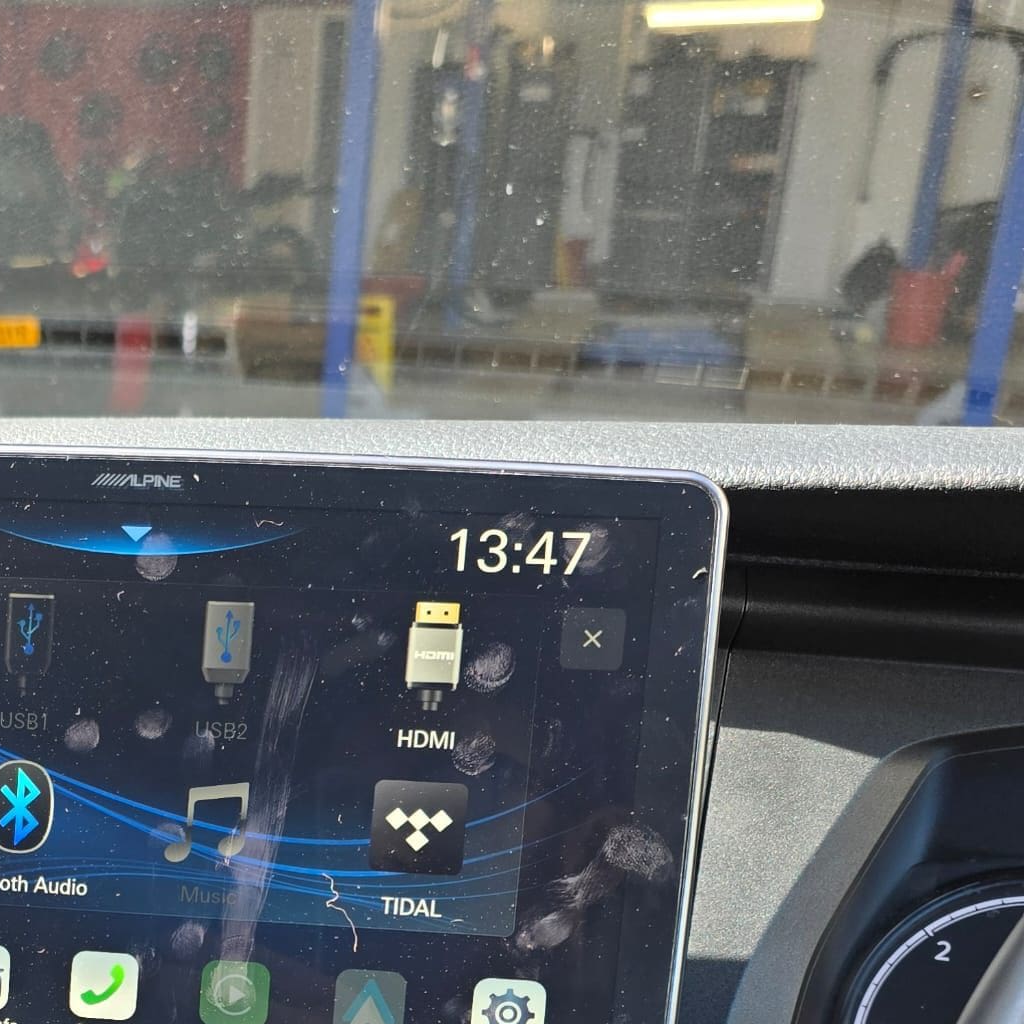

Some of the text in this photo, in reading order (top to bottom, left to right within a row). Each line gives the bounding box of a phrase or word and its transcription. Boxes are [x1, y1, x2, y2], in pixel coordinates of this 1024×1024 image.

[115, 473, 182, 488] ALPINE
[448, 527, 592, 576] 13:47
[413, 649, 455, 661] HDMI
[0, 711, 48, 732] USB1
[195, 721, 248, 741] USB2
[397, 729, 456, 750] HDMI
[33, 876, 88, 897] Audio
[180, 884, 237, 905] Music
[380, 896, 442, 919] TIDAL
[934, 940, 952, 963] 2
